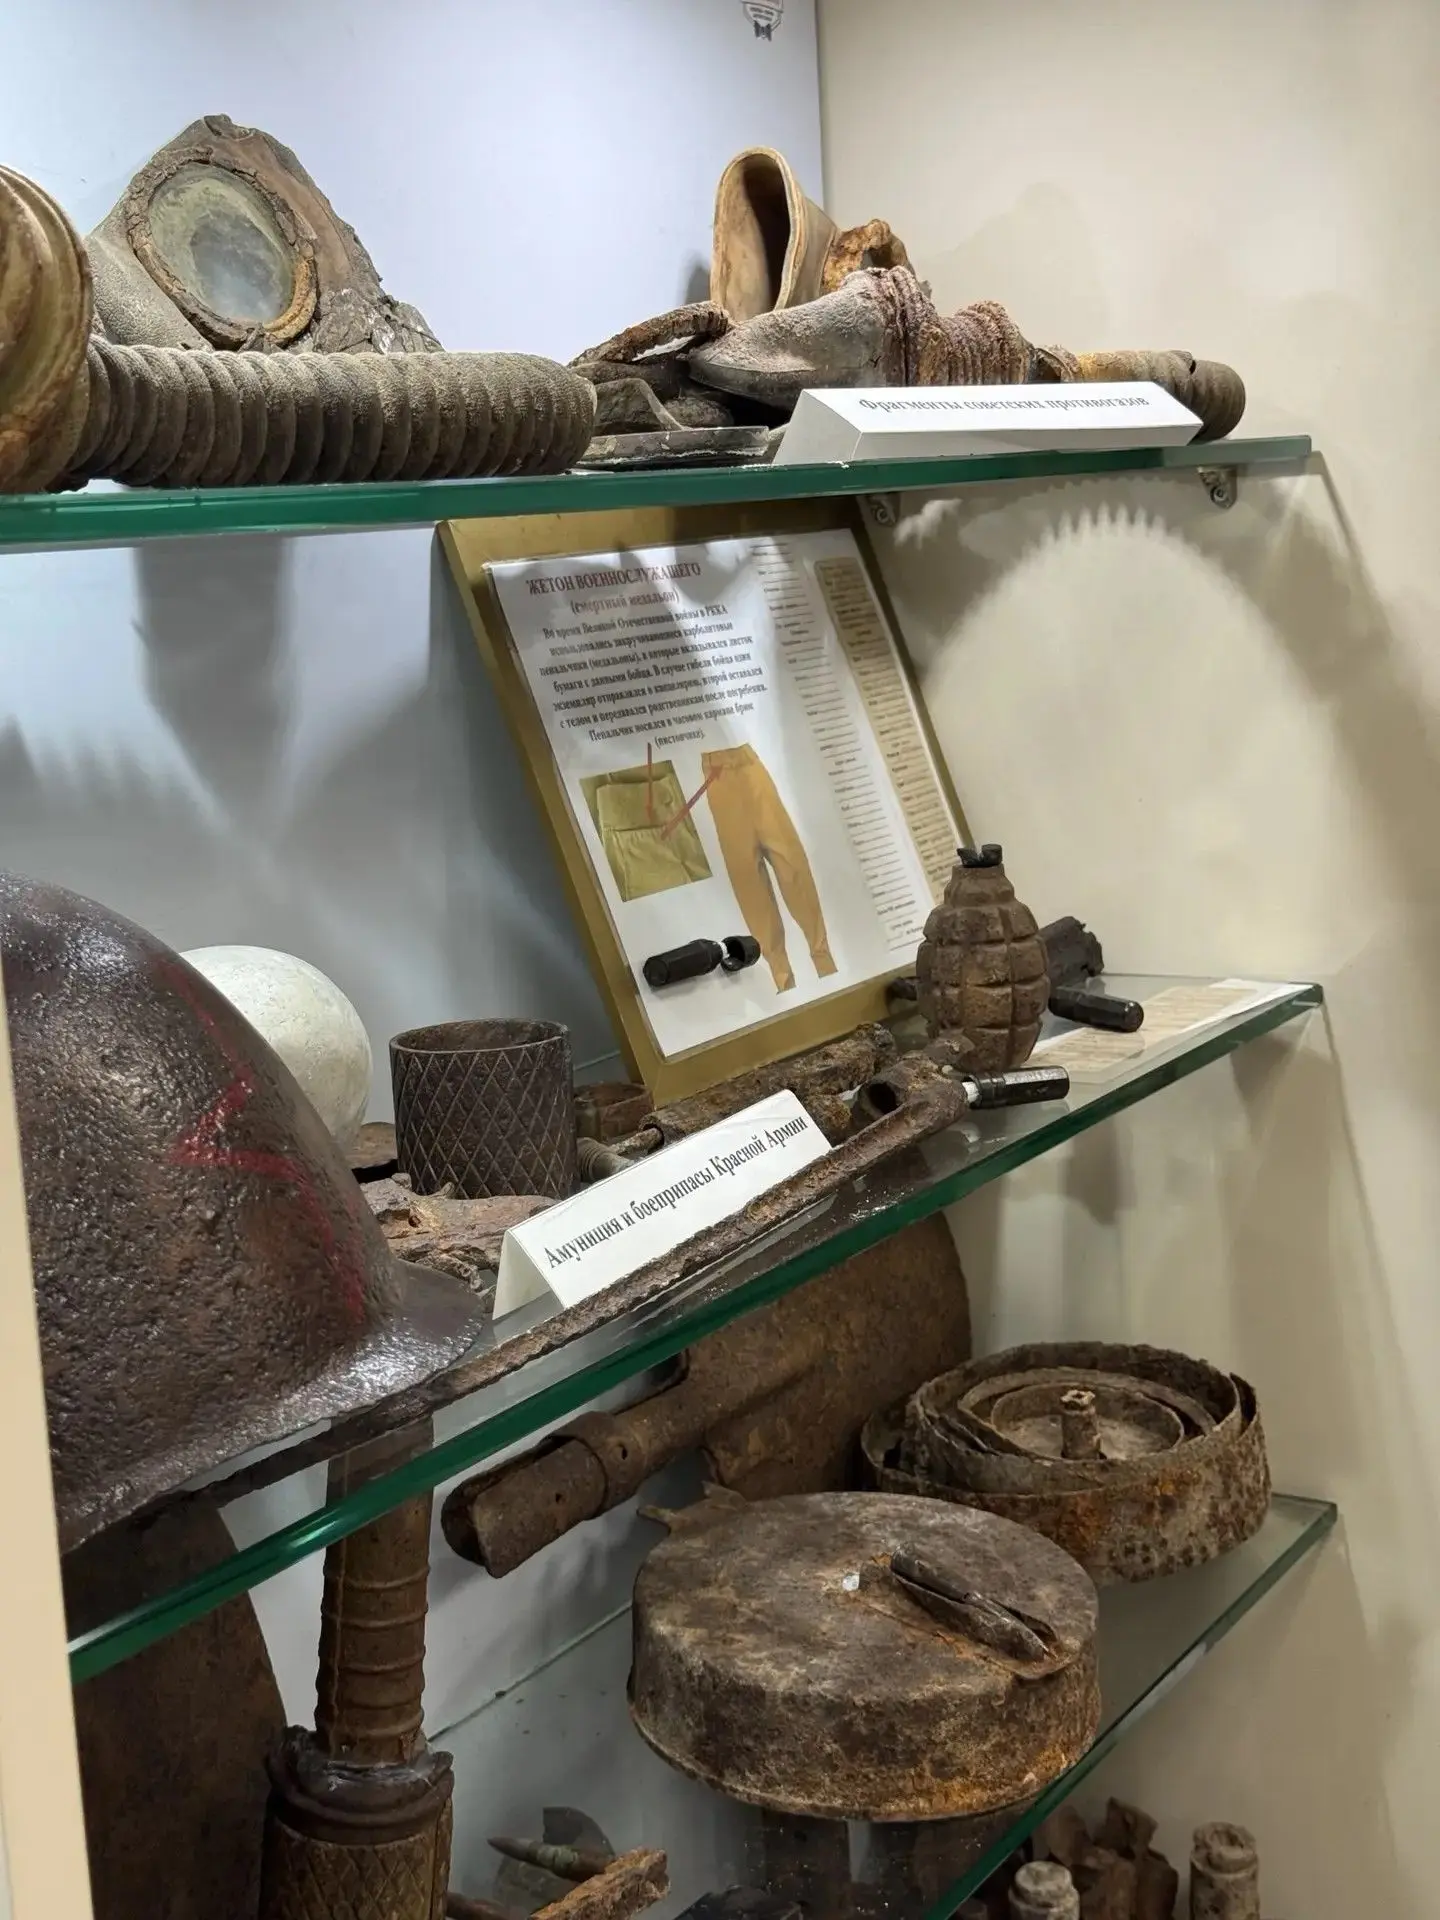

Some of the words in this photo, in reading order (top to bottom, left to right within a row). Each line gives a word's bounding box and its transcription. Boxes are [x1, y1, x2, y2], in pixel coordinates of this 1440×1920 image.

[859, 398, 962, 414] Фрагменты
[964, 399, 1045, 411] советских
[1046, 396, 1150, 412] противогазов
[527, 575, 576, 595] ЖЕТОН
[543, 1218, 625, 1269] Амуниция
[623, 1211, 635, 1230] и
[630, 1164, 717, 1222] боеприпасы
[709, 1135, 768, 1178] Красной
[764, 1116, 809, 1151] Армии
